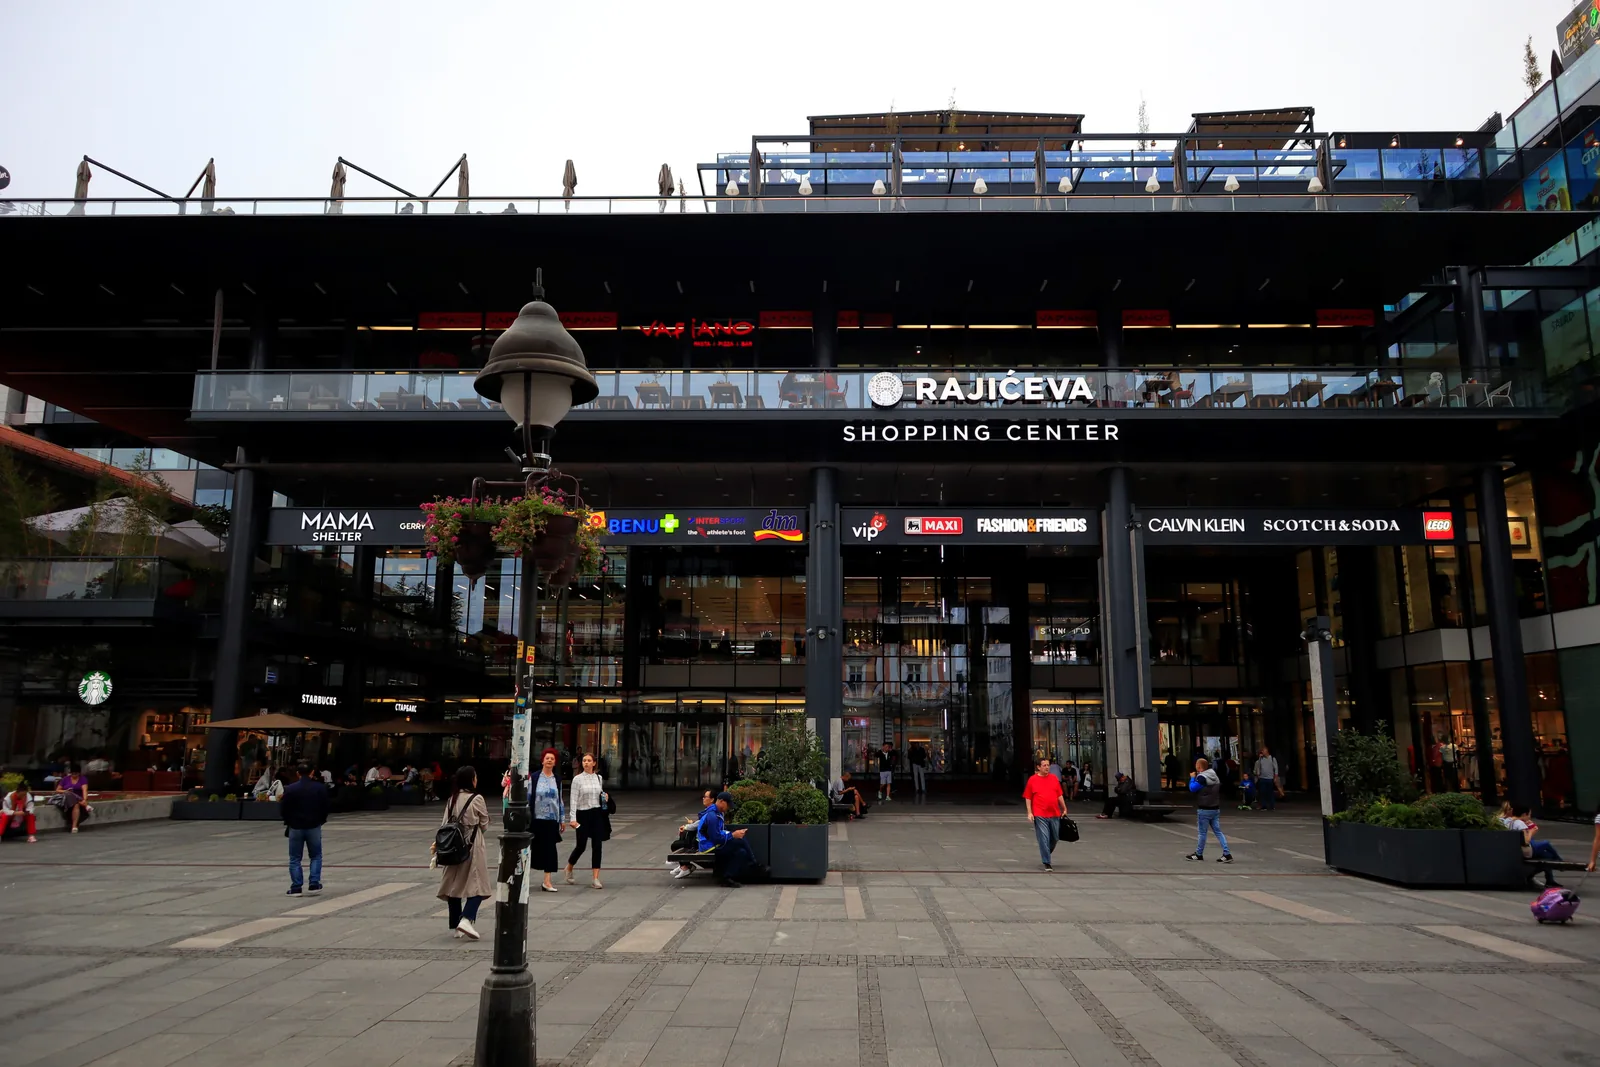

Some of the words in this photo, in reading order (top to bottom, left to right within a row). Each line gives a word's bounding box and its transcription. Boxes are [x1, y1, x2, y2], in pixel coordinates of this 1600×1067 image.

[916, 369, 1094, 400] RAJIĆEVA
[843, 425, 990, 441] SHOPPING
[1006, 425, 1119, 441] CENTER
[301, 512, 374, 530] MAMA
[609, 519, 659, 534] BENU
[695, 517, 746, 525] INTERSPORT
[762, 509, 797, 530] dm
[925, 520, 958, 531] MAXI
[977, 518, 1087, 532] FASHION&FRIENDS
[1149, 518, 1201, 532] CALVIN
[1204, 518, 1245, 532] KLEIN
[1263, 519, 1400, 532] SCOTCH&SODA
[1427, 520, 1451, 531] LEGO
[312, 532, 362, 541] SHELTER
[852, 522, 879, 541] vip
[302, 694, 337, 706] STARBUCKS
